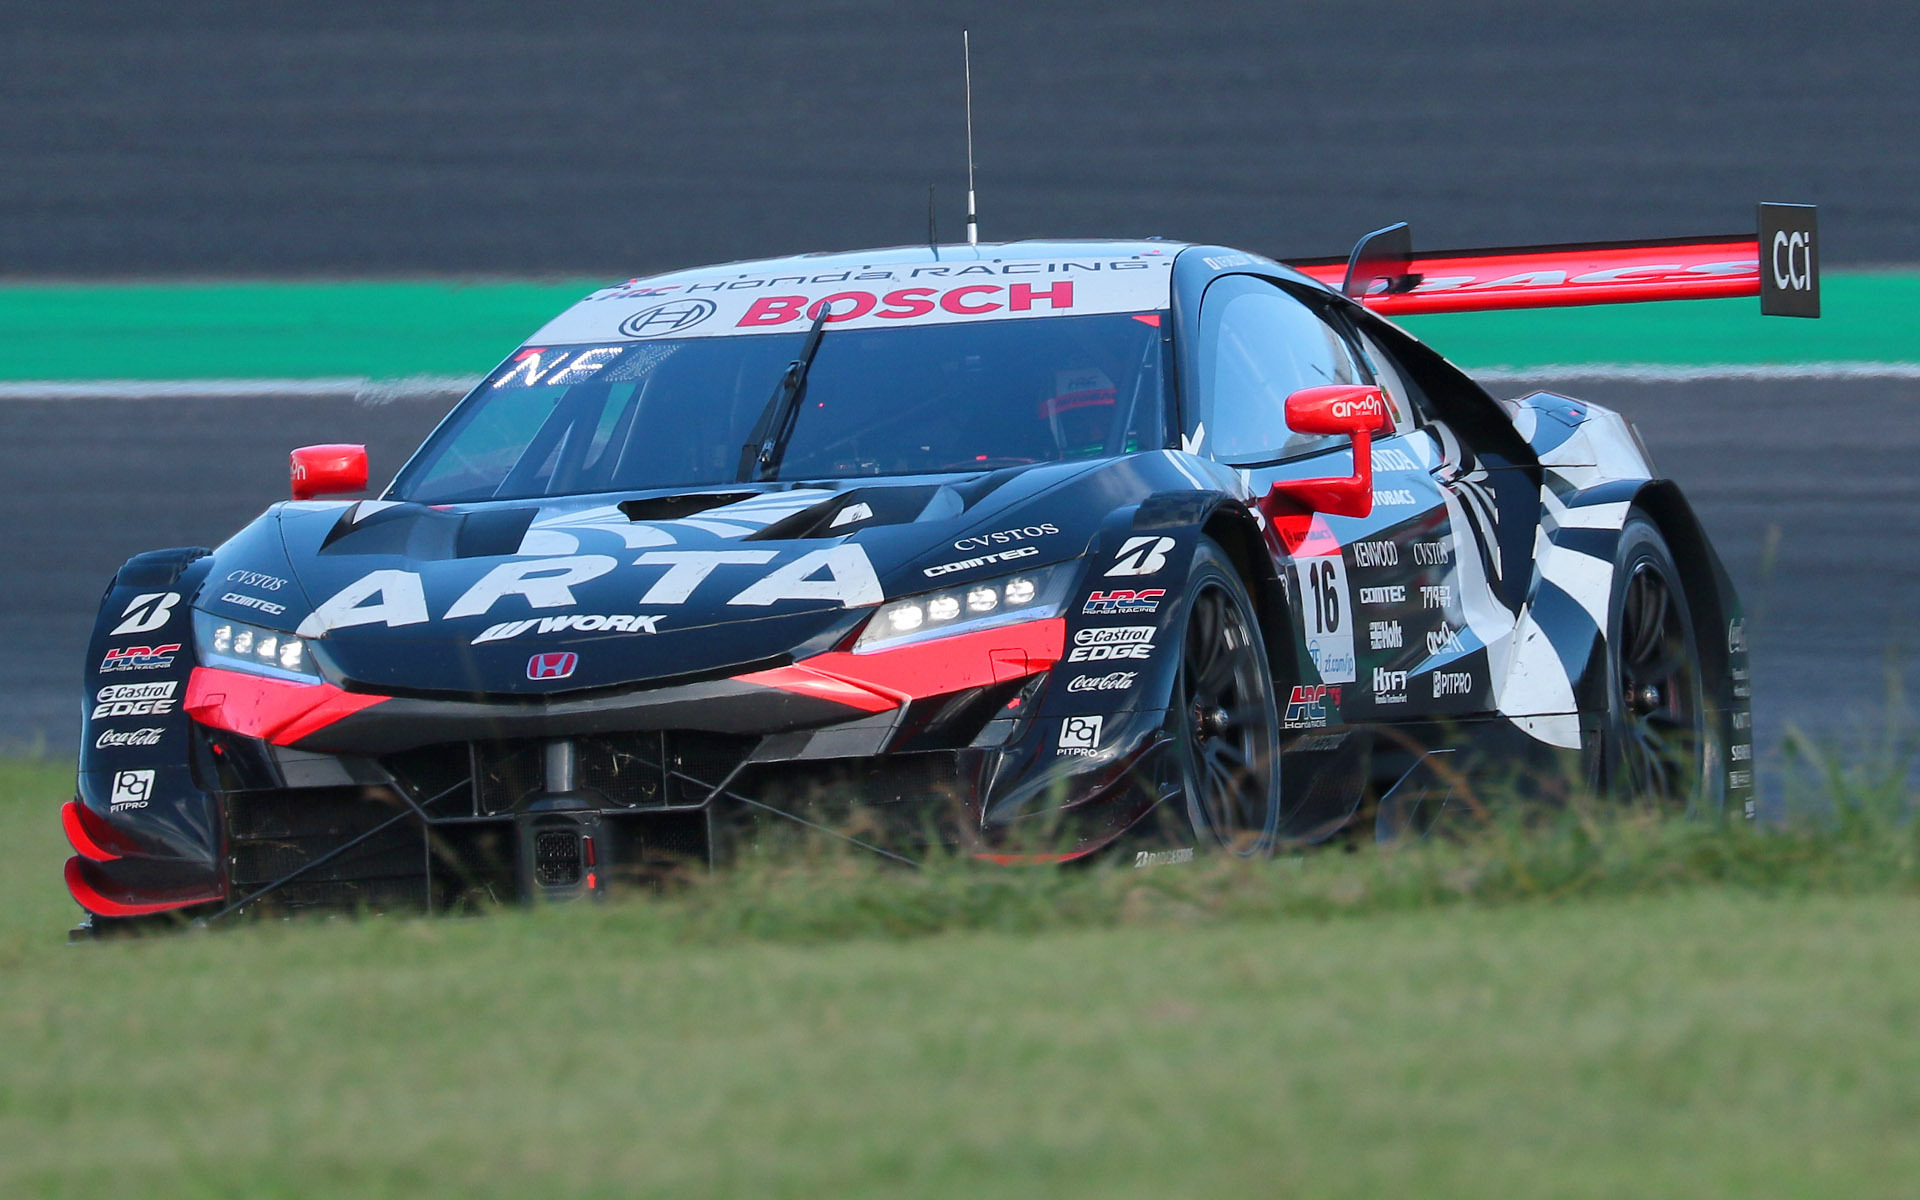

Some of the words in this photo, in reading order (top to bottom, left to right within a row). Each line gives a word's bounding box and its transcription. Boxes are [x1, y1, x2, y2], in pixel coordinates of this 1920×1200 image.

[686, 270, 893, 294] Honda
[910, 260, 1149, 279] RACING
[735, 281, 1074, 328] BOSCH
[1332, 394, 1382, 417] amon
[1345, 448, 1419, 472] ONDA
[954, 522, 1060, 551] CVSTOS
[923, 546, 1040, 578] COMTEC
[1353, 541, 1399, 568] KENWOOD
[1413, 541, 1449, 566] CVSTOS
[227, 569, 288, 591] CVSTOS
[296, 543, 886, 640] ARTA
[221, 592, 286, 616] COMTEC
[1083, 588, 1167, 612] HRC
[1309, 560, 1340, 633] 16
[1360, 585, 1406, 604] COMTEC
[537, 614, 668, 635] WORK
[1093, 628, 1150, 643] Castrol
[1382, 620, 1403, 650] Holts
[1426, 621, 1465, 656] amon
[101, 643, 182, 669] HRC
[1067, 643, 1157, 663] EDGE
[115, 684, 170, 699] Castrol
[1441, 672, 1472, 695] PITPRO
[91, 699, 178, 720] EDGE
[1283, 684, 1327, 721] HRC
[1056, 748, 1099, 757] PITPRO
[110, 801, 149, 814] PITPRO
